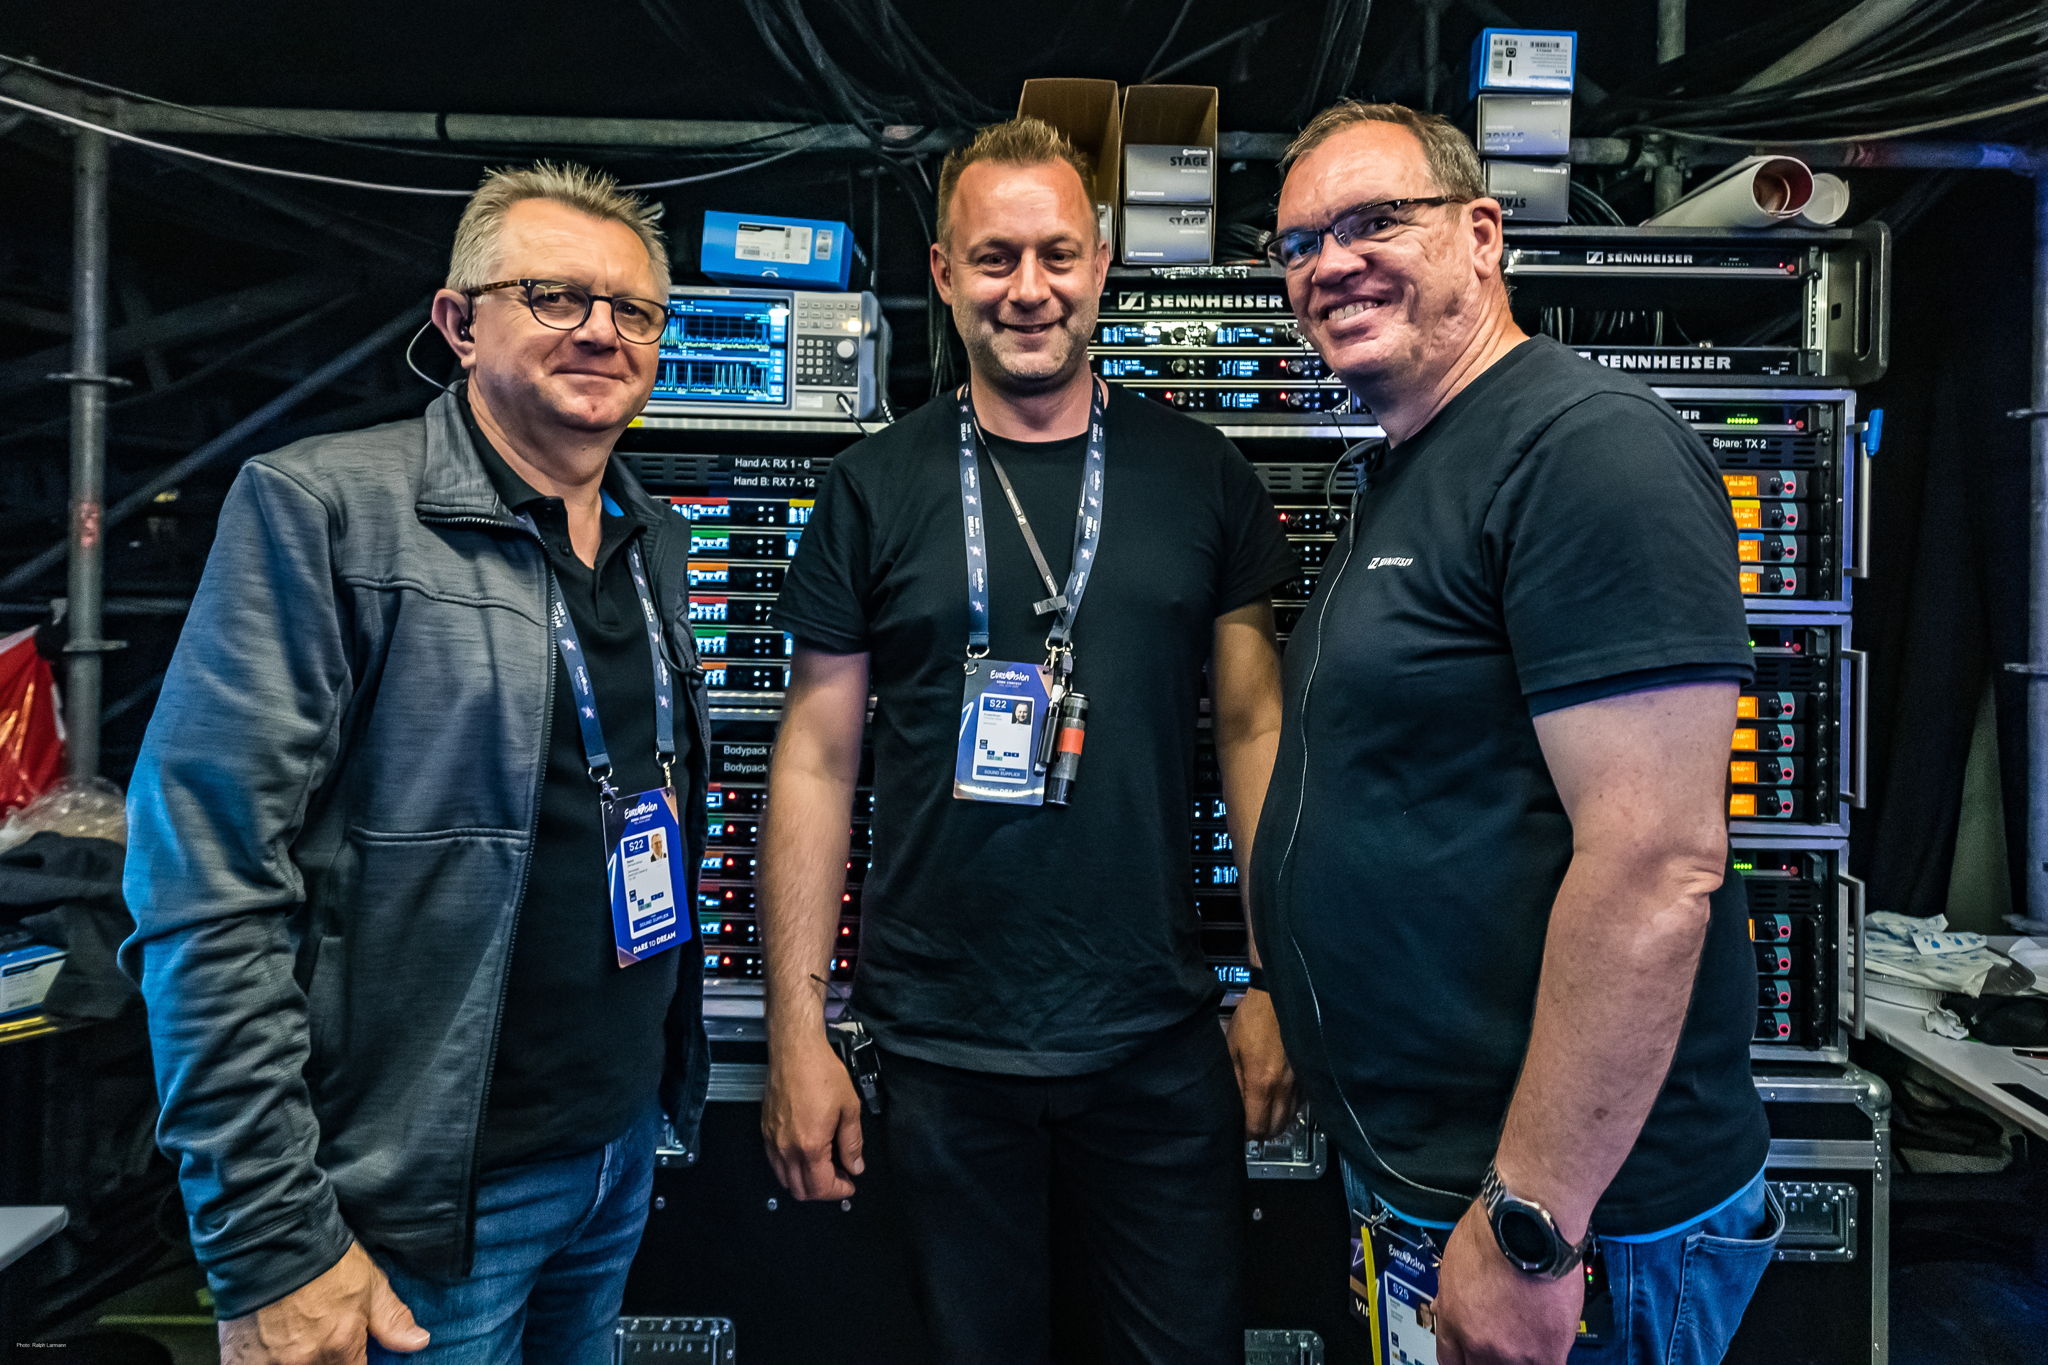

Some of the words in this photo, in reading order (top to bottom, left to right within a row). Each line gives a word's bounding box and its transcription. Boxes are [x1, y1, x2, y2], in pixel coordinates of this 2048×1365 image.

[1170, 156, 1208, 166] STAGE
[1494, 197, 1527, 208] STAG
[1168, 217, 1206, 227] STAGE
[1607, 253, 1693, 264] SENNHEISER
[1150, 294, 1283, 308] SENNHEISER
[1598, 353, 1731, 370] SENNHEISER
[1713, 438, 1742, 450] Spare:
[1744, 439, 1758, 449] TX
[1760, 439, 1767, 449] 2
[735, 458, 760, 468] Hand
[760, 459, 771, 468] A:
[773, 459, 788, 469] RX
[790, 460, 795, 469] 1
[804, 460, 811, 469] 6
[734, 477, 759, 486] Hand
[759, 477, 771, 487] B:
[773, 477, 788, 487] RX
[789, 478, 796, 487] 7
[804, 478, 815, 488] 12
[989, 699, 1007, 709] S22
[723, 745, 767, 757] Bodypack
[723, 762, 768, 774] Bodypack
[628, 839, 645, 852] S22
[632, 941, 649, 954] DARE
[648, 938, 657, 948] TO
[656, 930, 677, 945] DREAM
[1392, 1282, 1410, 1301] S25
